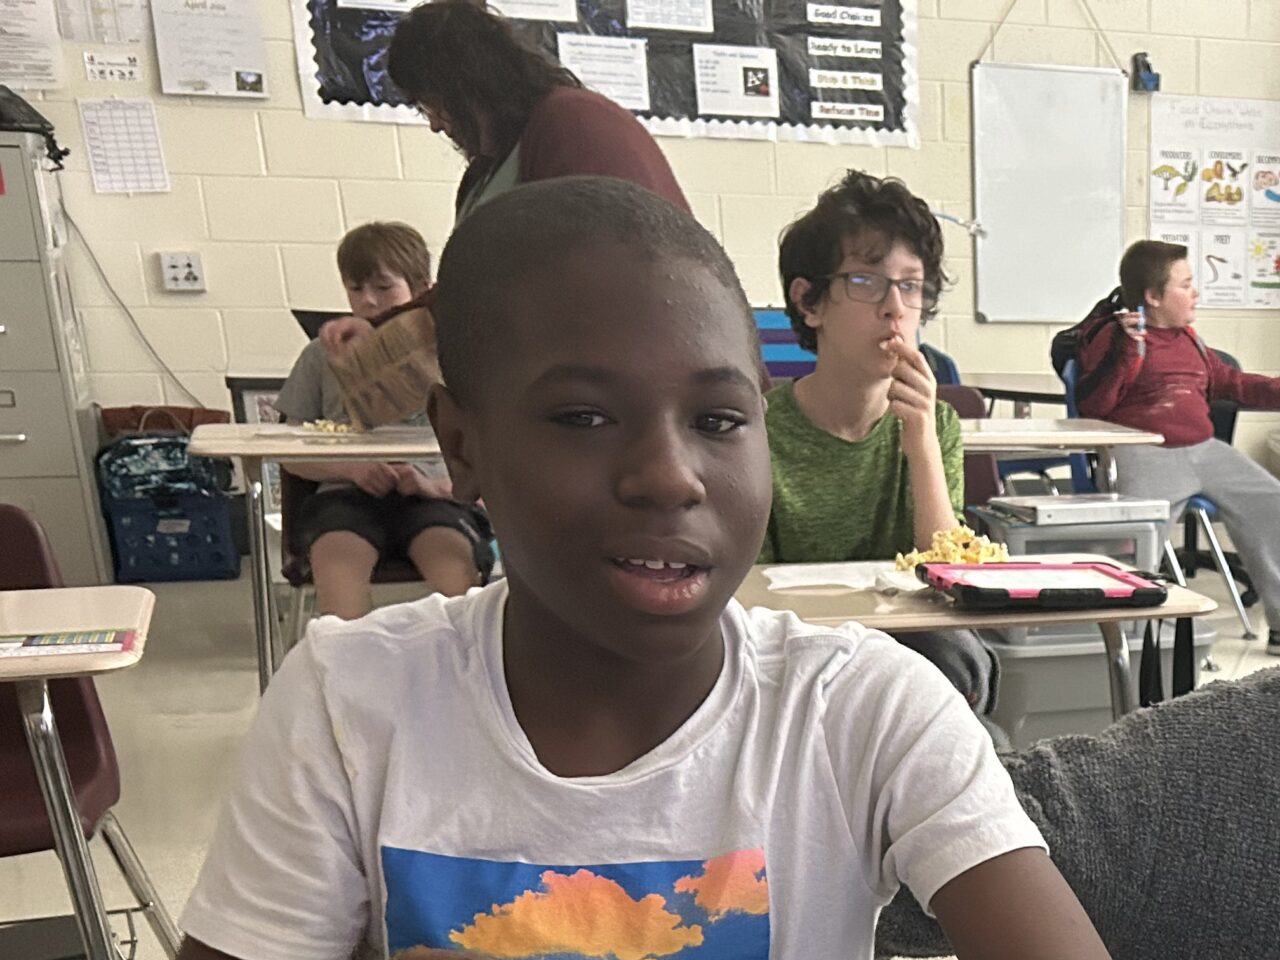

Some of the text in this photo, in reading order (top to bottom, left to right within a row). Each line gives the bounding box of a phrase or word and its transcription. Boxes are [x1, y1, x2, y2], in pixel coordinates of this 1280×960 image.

[810, 37, 882, 56] Ready to Learn
